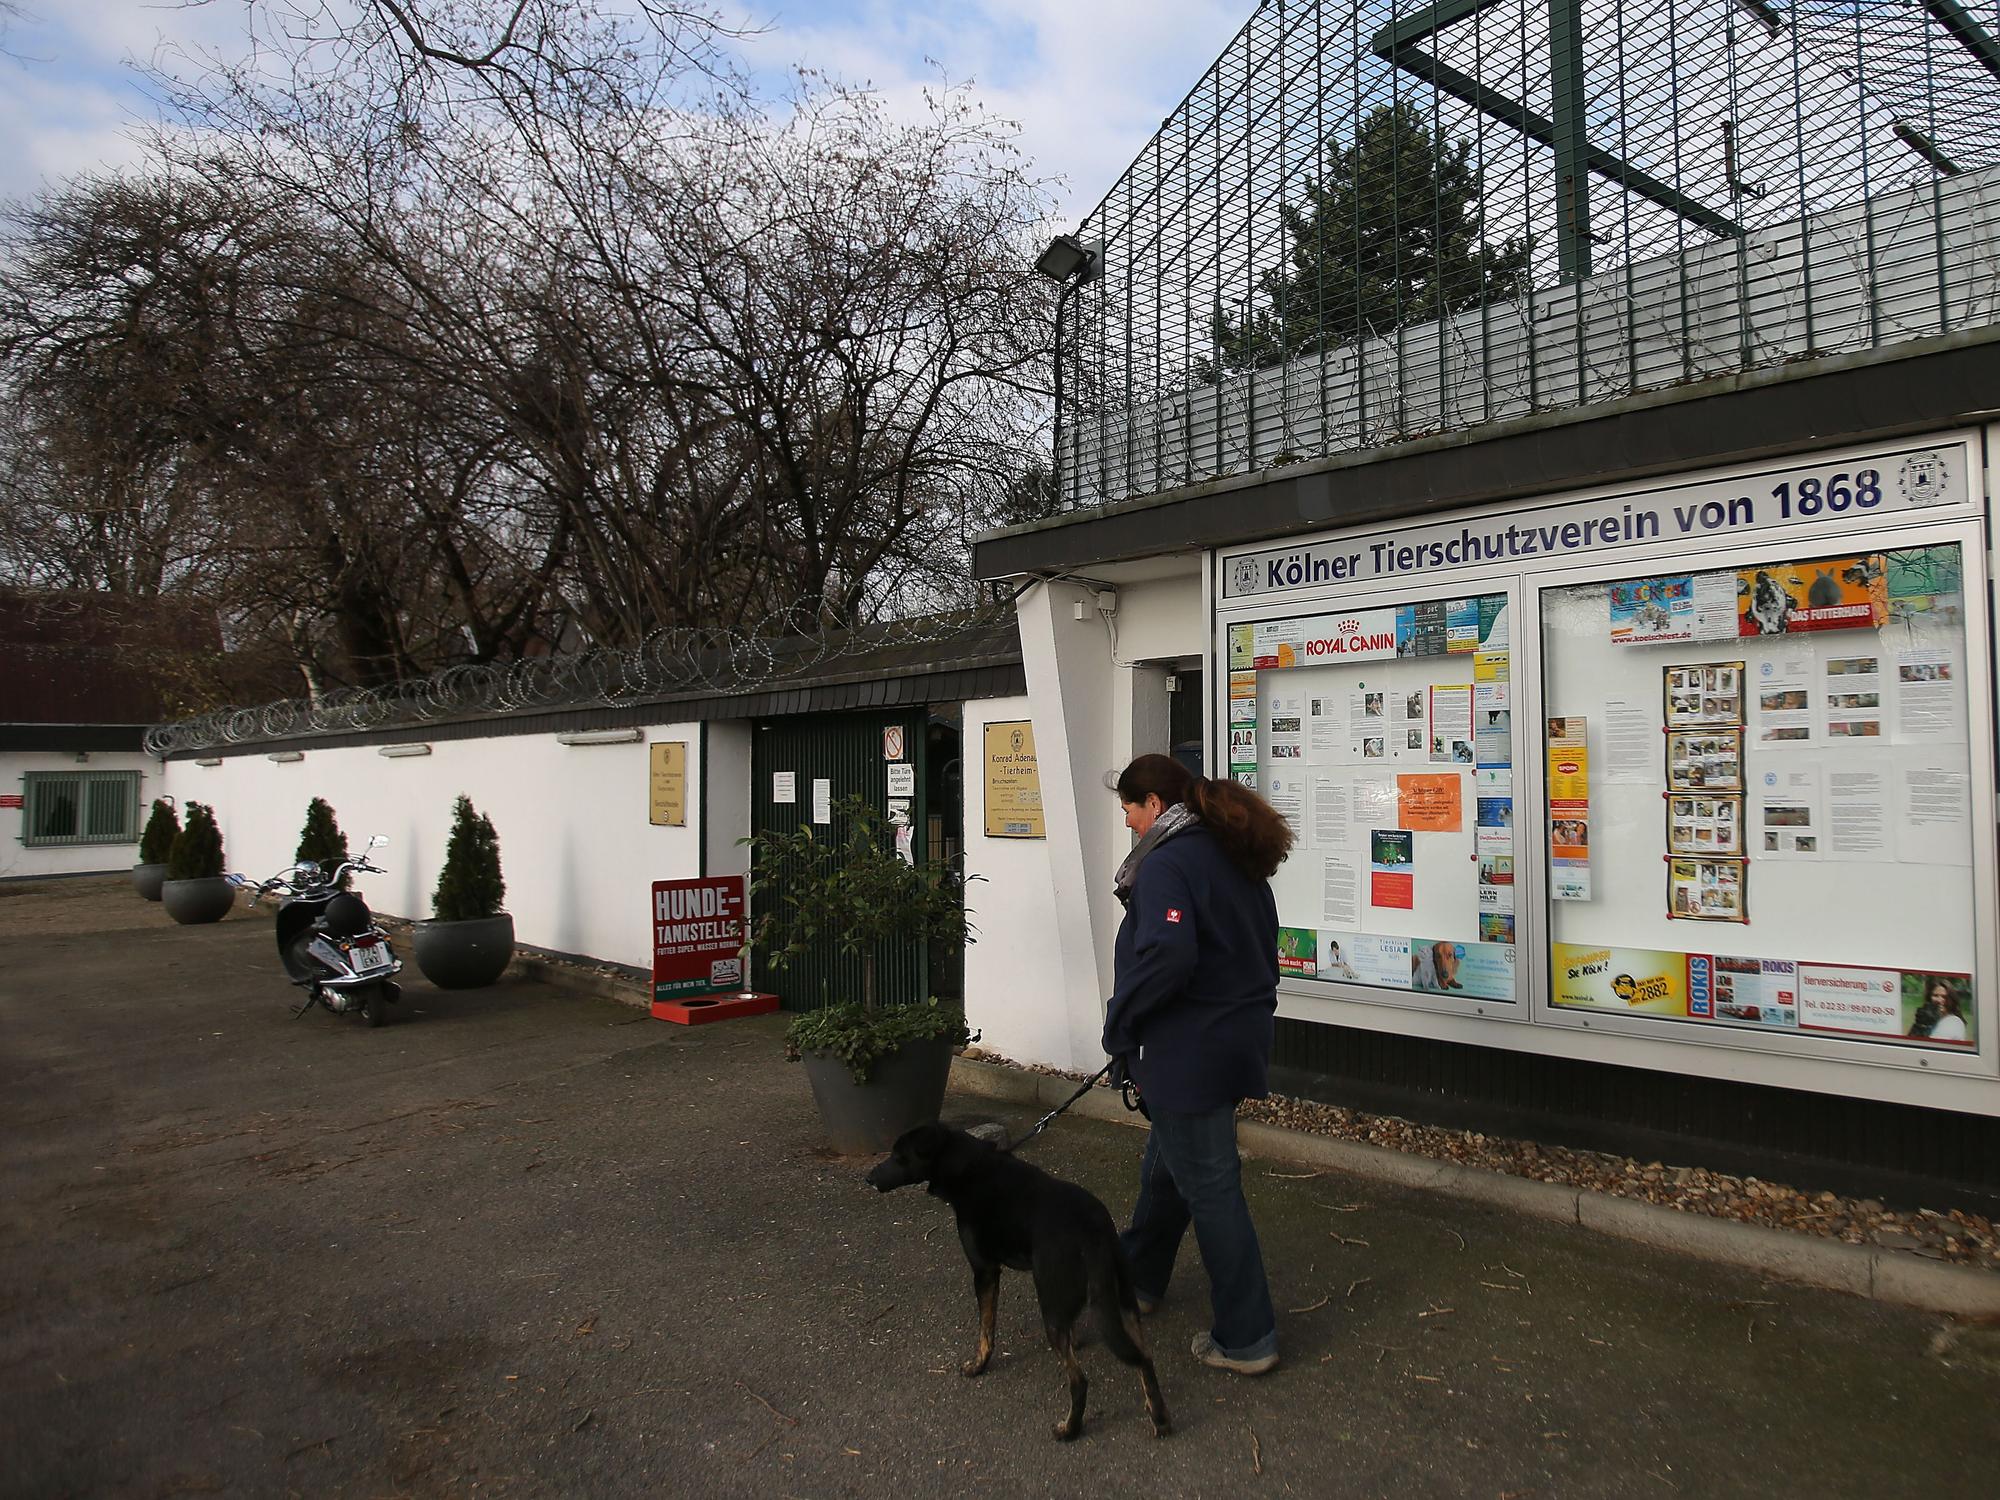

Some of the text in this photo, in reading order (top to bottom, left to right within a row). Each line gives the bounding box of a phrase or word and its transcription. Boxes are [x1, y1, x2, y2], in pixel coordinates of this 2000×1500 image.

[1267, 469, 1882, 587] Kölner Tierschutzverein von 1868
[1791, 605, 1870, 621] DAS FUTTERHAUS
[1306, 637, 1347, 656] ROYAL
[1349, 633, 1394, 652] CANIN
[1611, 632, 1692, 644] www.koelschfest.de
[992, 754, 1013, 763] Konrad
[656, 886, 741, 921] HUNDE-
[657, 940, 741, 956] FUTTER SUPER. WASSER NORMAL.
[1380, 945, 1401, 953] LESIA
[1762, 960, 1794, 974] ROKIS
[657, 982, 671, 991] ALLES
[672, 981, 682, 990] FÜR
[683, 980, 695, 988] MEIN
[1640, 982, 1669, 1000] 2882
[1690, 956, 1710, 1014] ROKIS
[1804, 1000, 1817, 1008] Tel.
